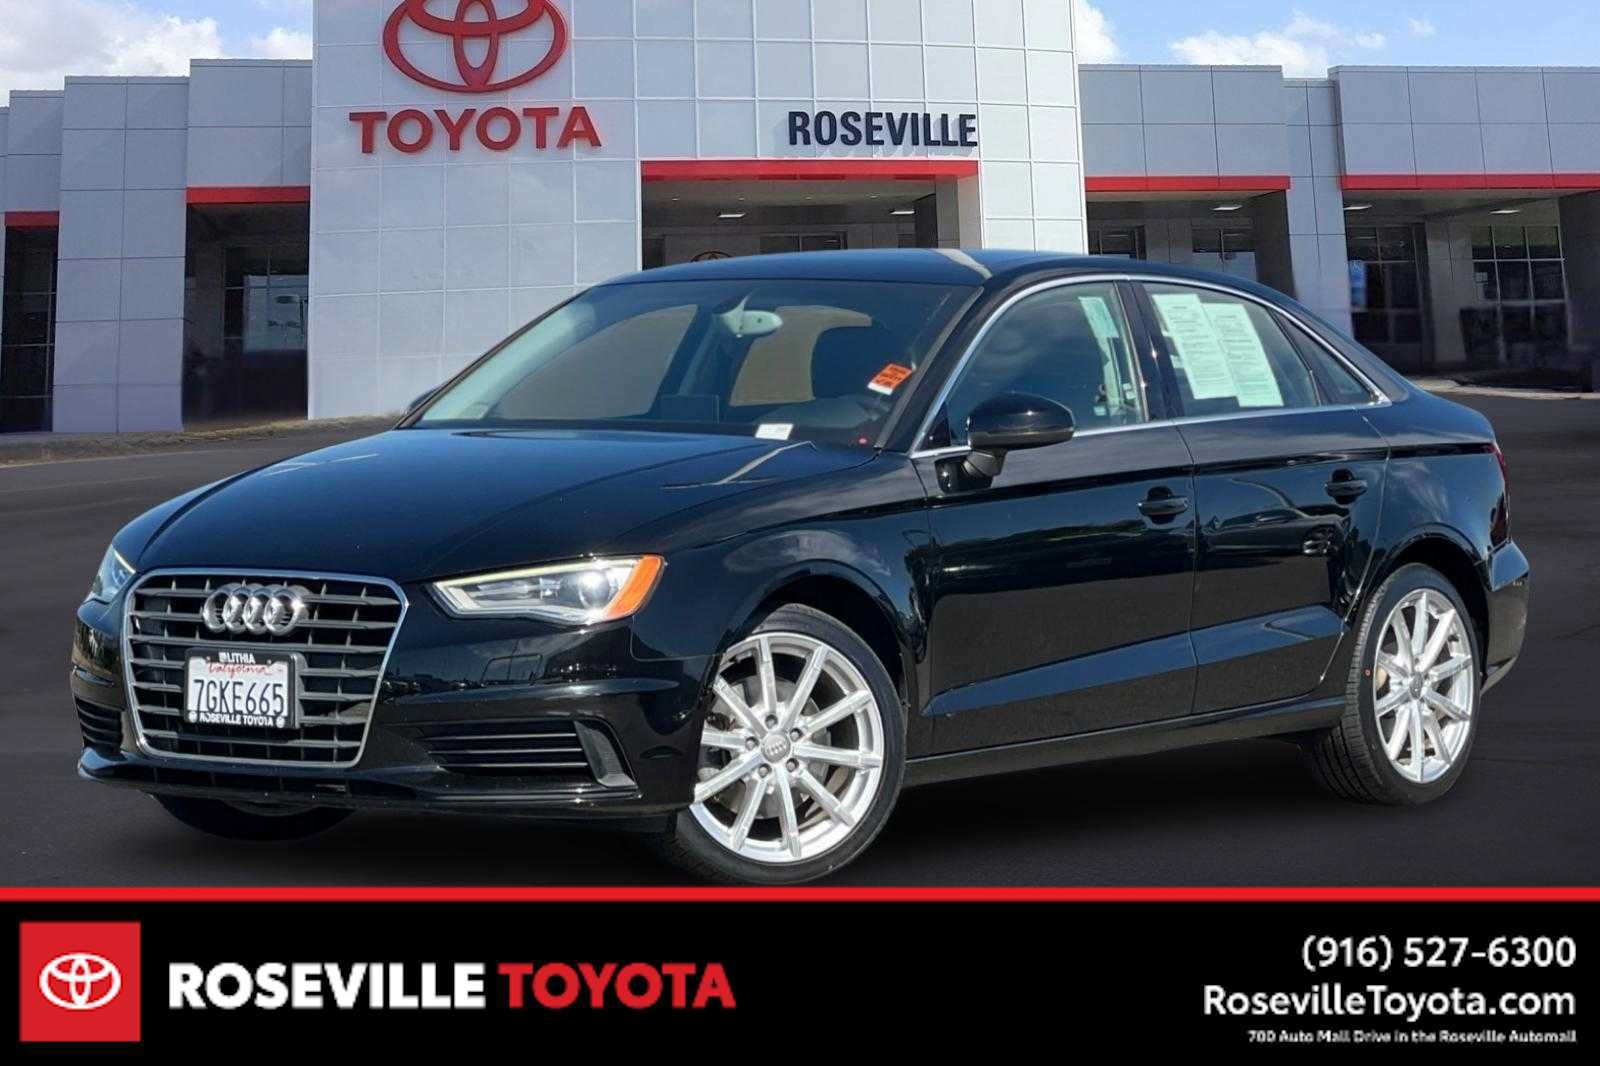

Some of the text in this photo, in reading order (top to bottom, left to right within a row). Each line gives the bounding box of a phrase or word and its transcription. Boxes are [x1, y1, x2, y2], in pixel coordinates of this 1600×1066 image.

[348, 105, 603, 155] TOYOTA
[788, 110, 978, 148] ROSEVILLE
[225, 652, 256, 664] LITHIA
[193, 679, 284, 715] 7GKE665
[199, 712, 274, 727] ROSEVILLE TOYOTA
